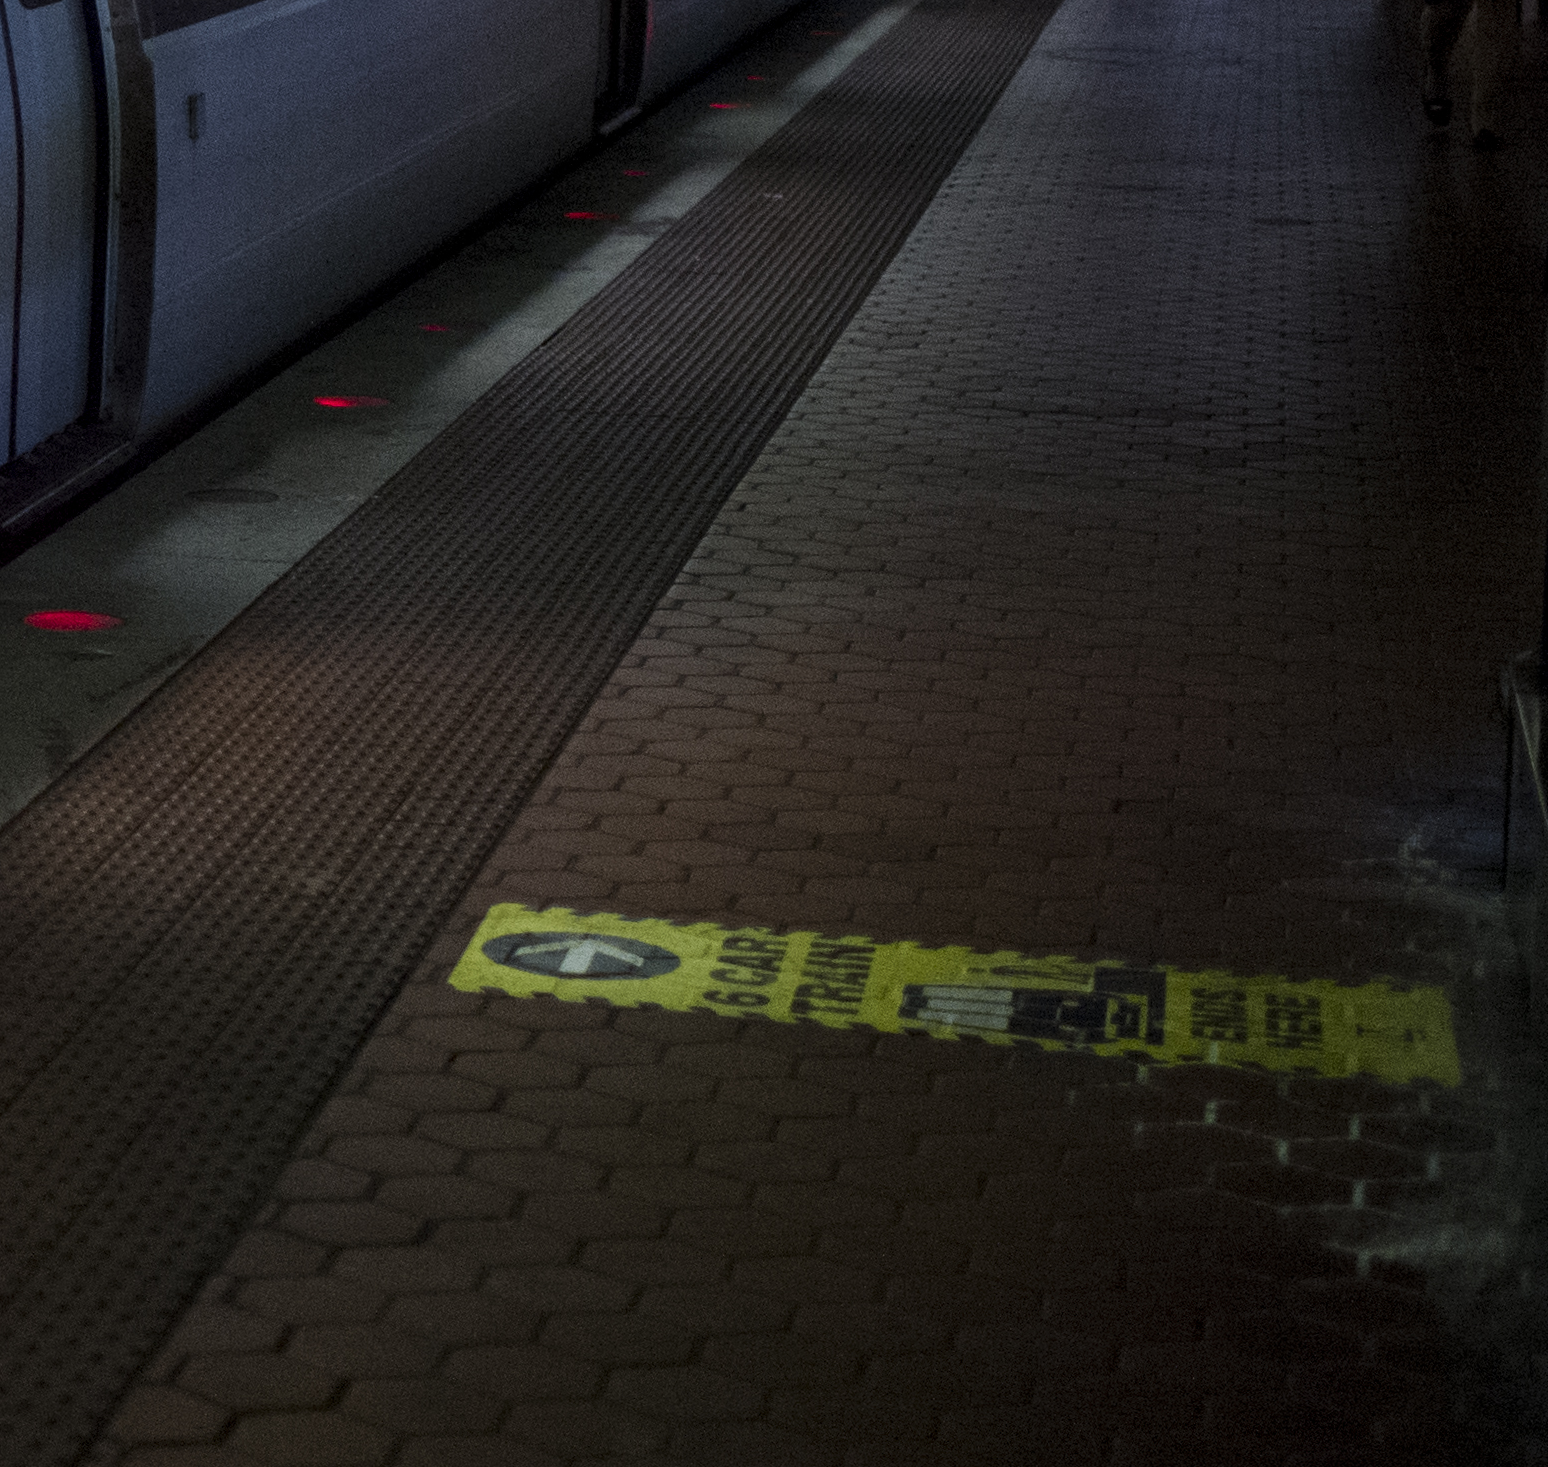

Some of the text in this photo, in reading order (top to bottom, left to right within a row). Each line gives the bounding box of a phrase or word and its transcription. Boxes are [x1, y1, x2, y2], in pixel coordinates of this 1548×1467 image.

[703, 936, 789, 1008] 6 CAR
[790, 940, 876, 1016] TRAIN
[1264, 993, 1322, 1051] HERE
